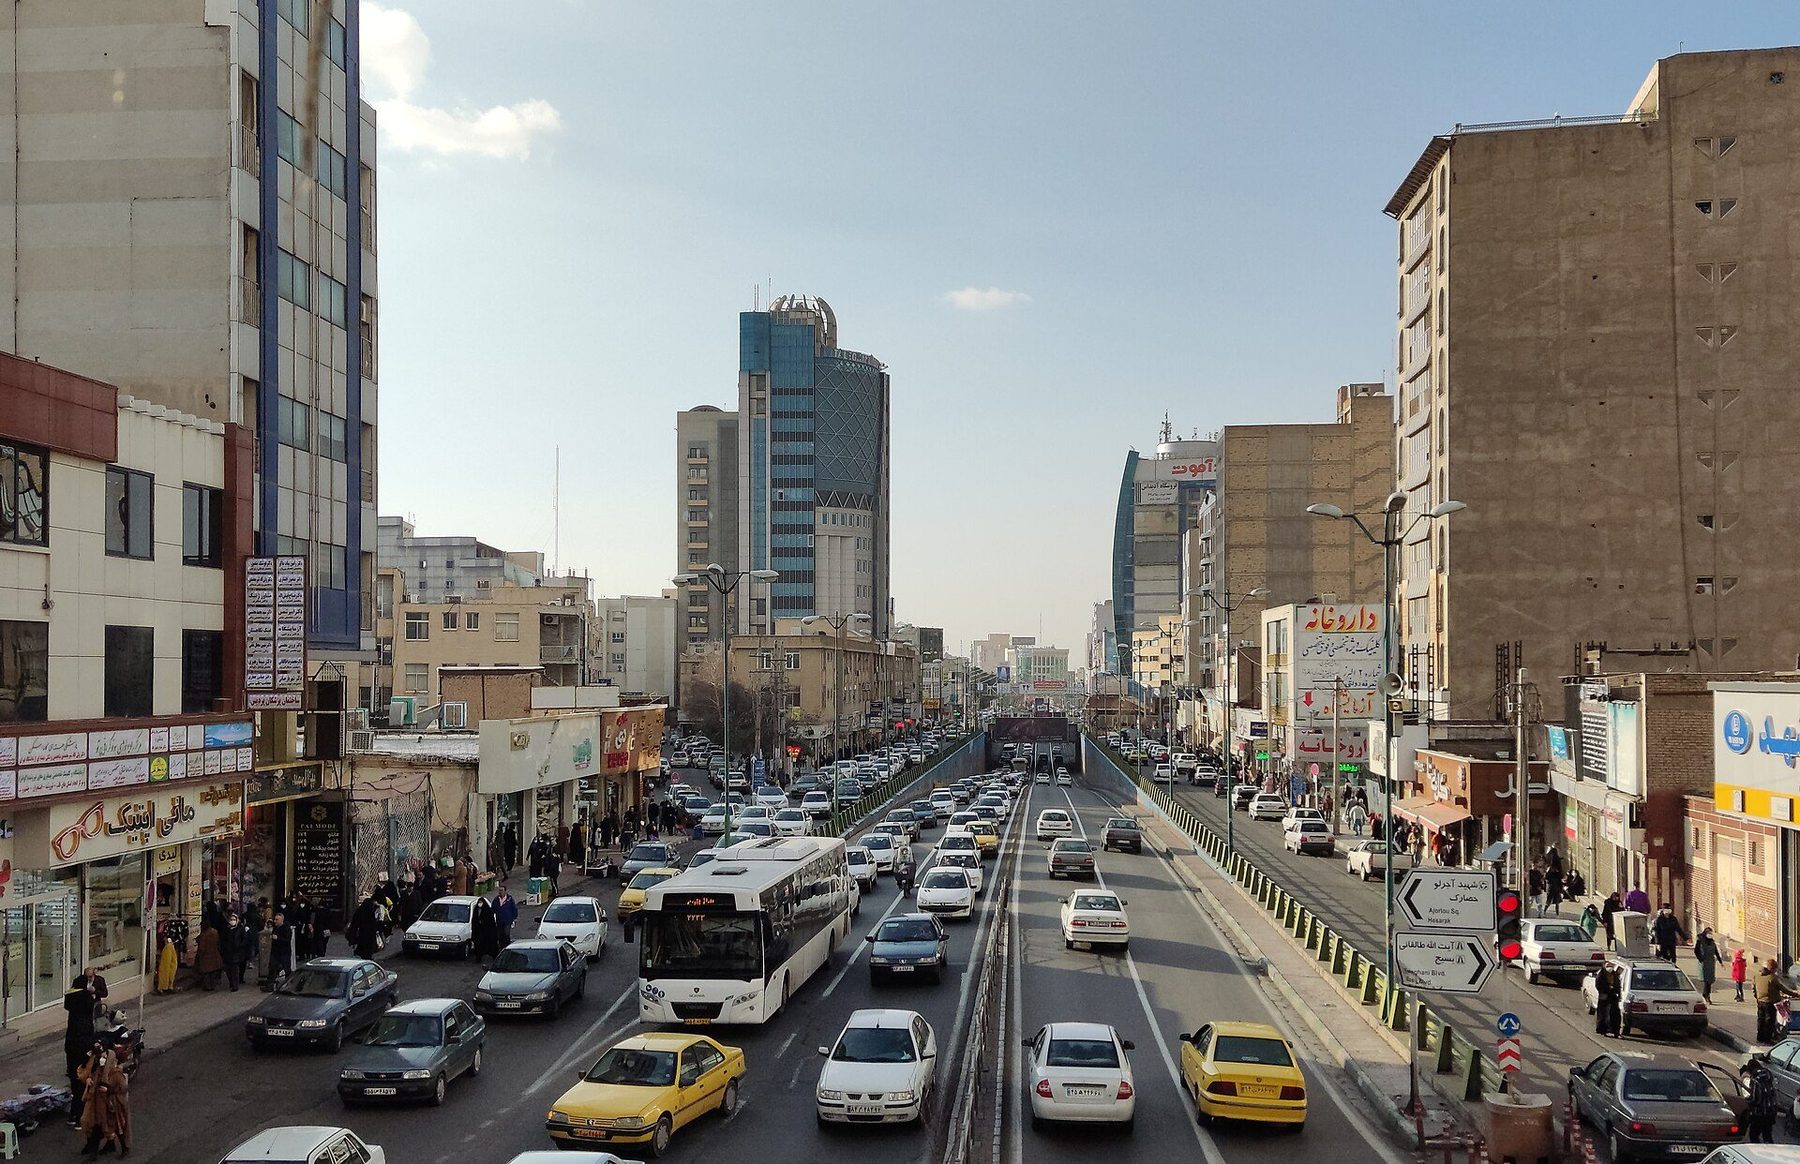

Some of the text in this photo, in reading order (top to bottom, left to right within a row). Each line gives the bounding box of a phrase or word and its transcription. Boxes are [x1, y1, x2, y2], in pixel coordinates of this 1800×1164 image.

[1172, 458, 1213, 477] آموت
[1305, 606, 1377, 631] داروخانه
[1365, 663, 1382, 677] شماره
[1362, 680, 1377, 688] تعرفه
[1299, 736, 1368, 759] اروخانه
[106, 801, 155, 844] اپتیک
[159, 796, 195, 838] مانی
[1458, 881, 1478, 890] شهید
[1449, 894, 1478, 903] حصارک
[1399, 941, 1454, 951] آیت الله طالقانی
[1435, 956, 1454, 965] بسیج
